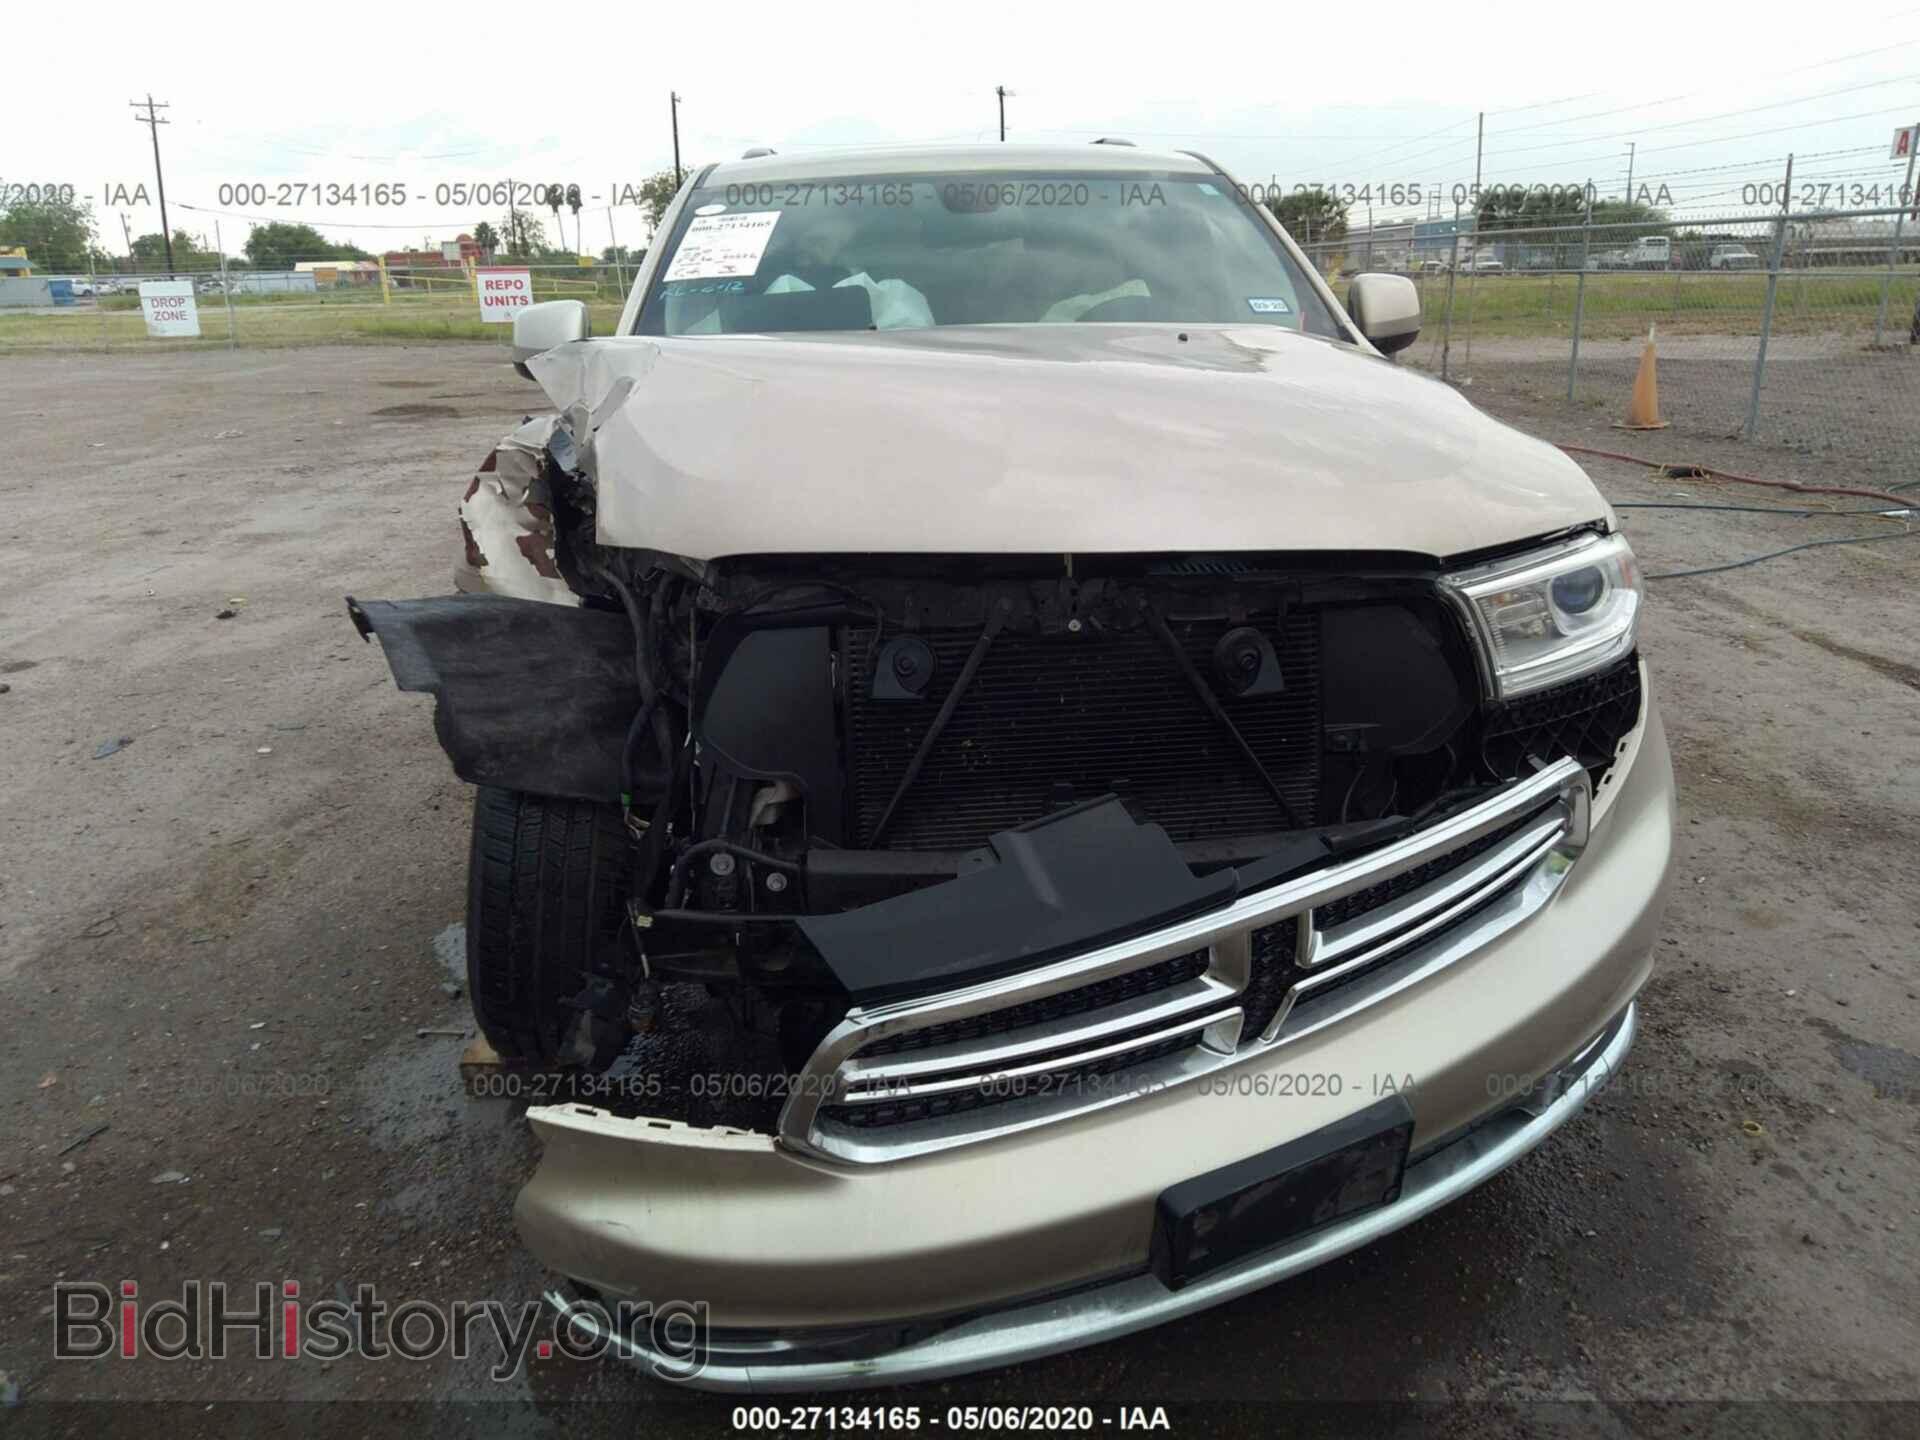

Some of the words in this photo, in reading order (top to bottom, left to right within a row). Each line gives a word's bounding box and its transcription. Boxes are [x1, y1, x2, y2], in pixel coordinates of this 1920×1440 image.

[1896, 130, 1910, 155] A
[485, 279, 524, 290] REPO
[151, 297, 185, 308] DROP
[484, 295, 529, 307] UNITS
[154, 311, 189, 321] ZONE
